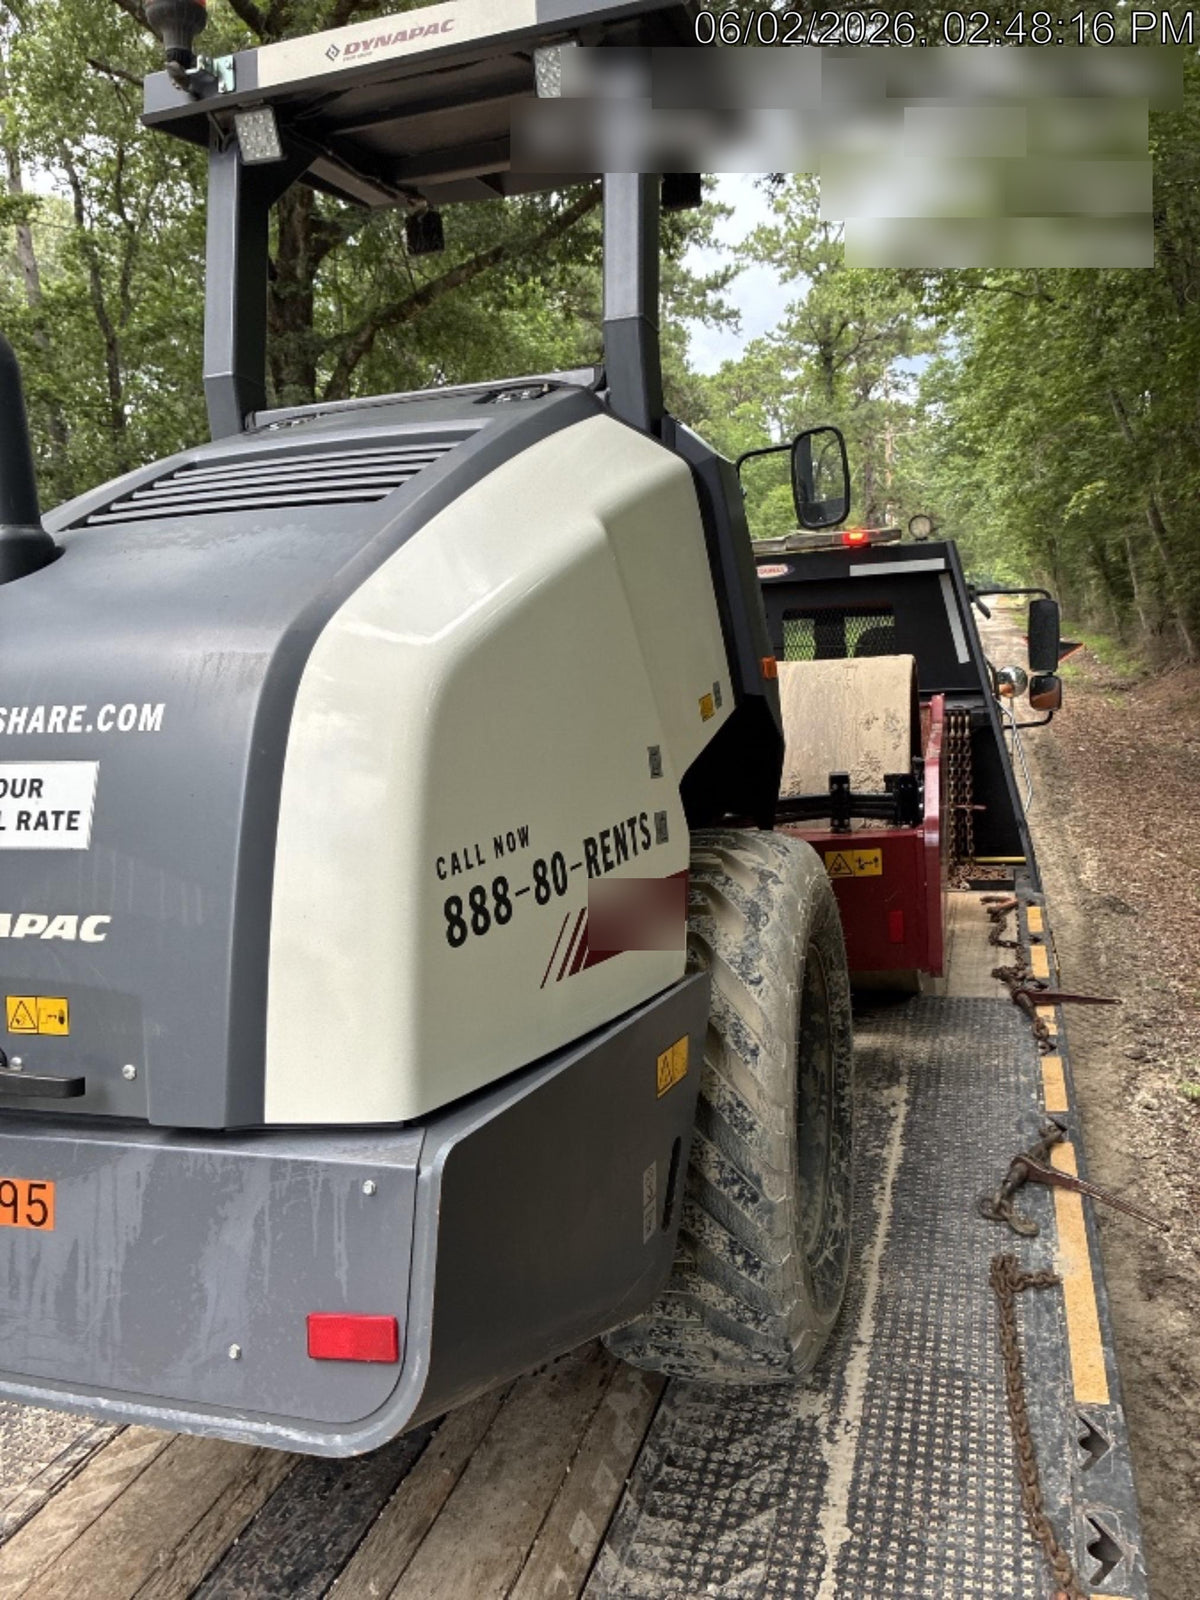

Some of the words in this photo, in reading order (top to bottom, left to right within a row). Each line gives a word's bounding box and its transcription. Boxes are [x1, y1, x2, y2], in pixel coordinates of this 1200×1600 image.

[343, 19, 455, 55] DYNAPAC
[16, 810, 80, 831] RATE
[436, 844, 486, 880] CALL
[493, 825, 529, 859] NOW
[444, 812, 651, 948] 888-80-RENTS
[0, 1180, 48, 1227] 95
